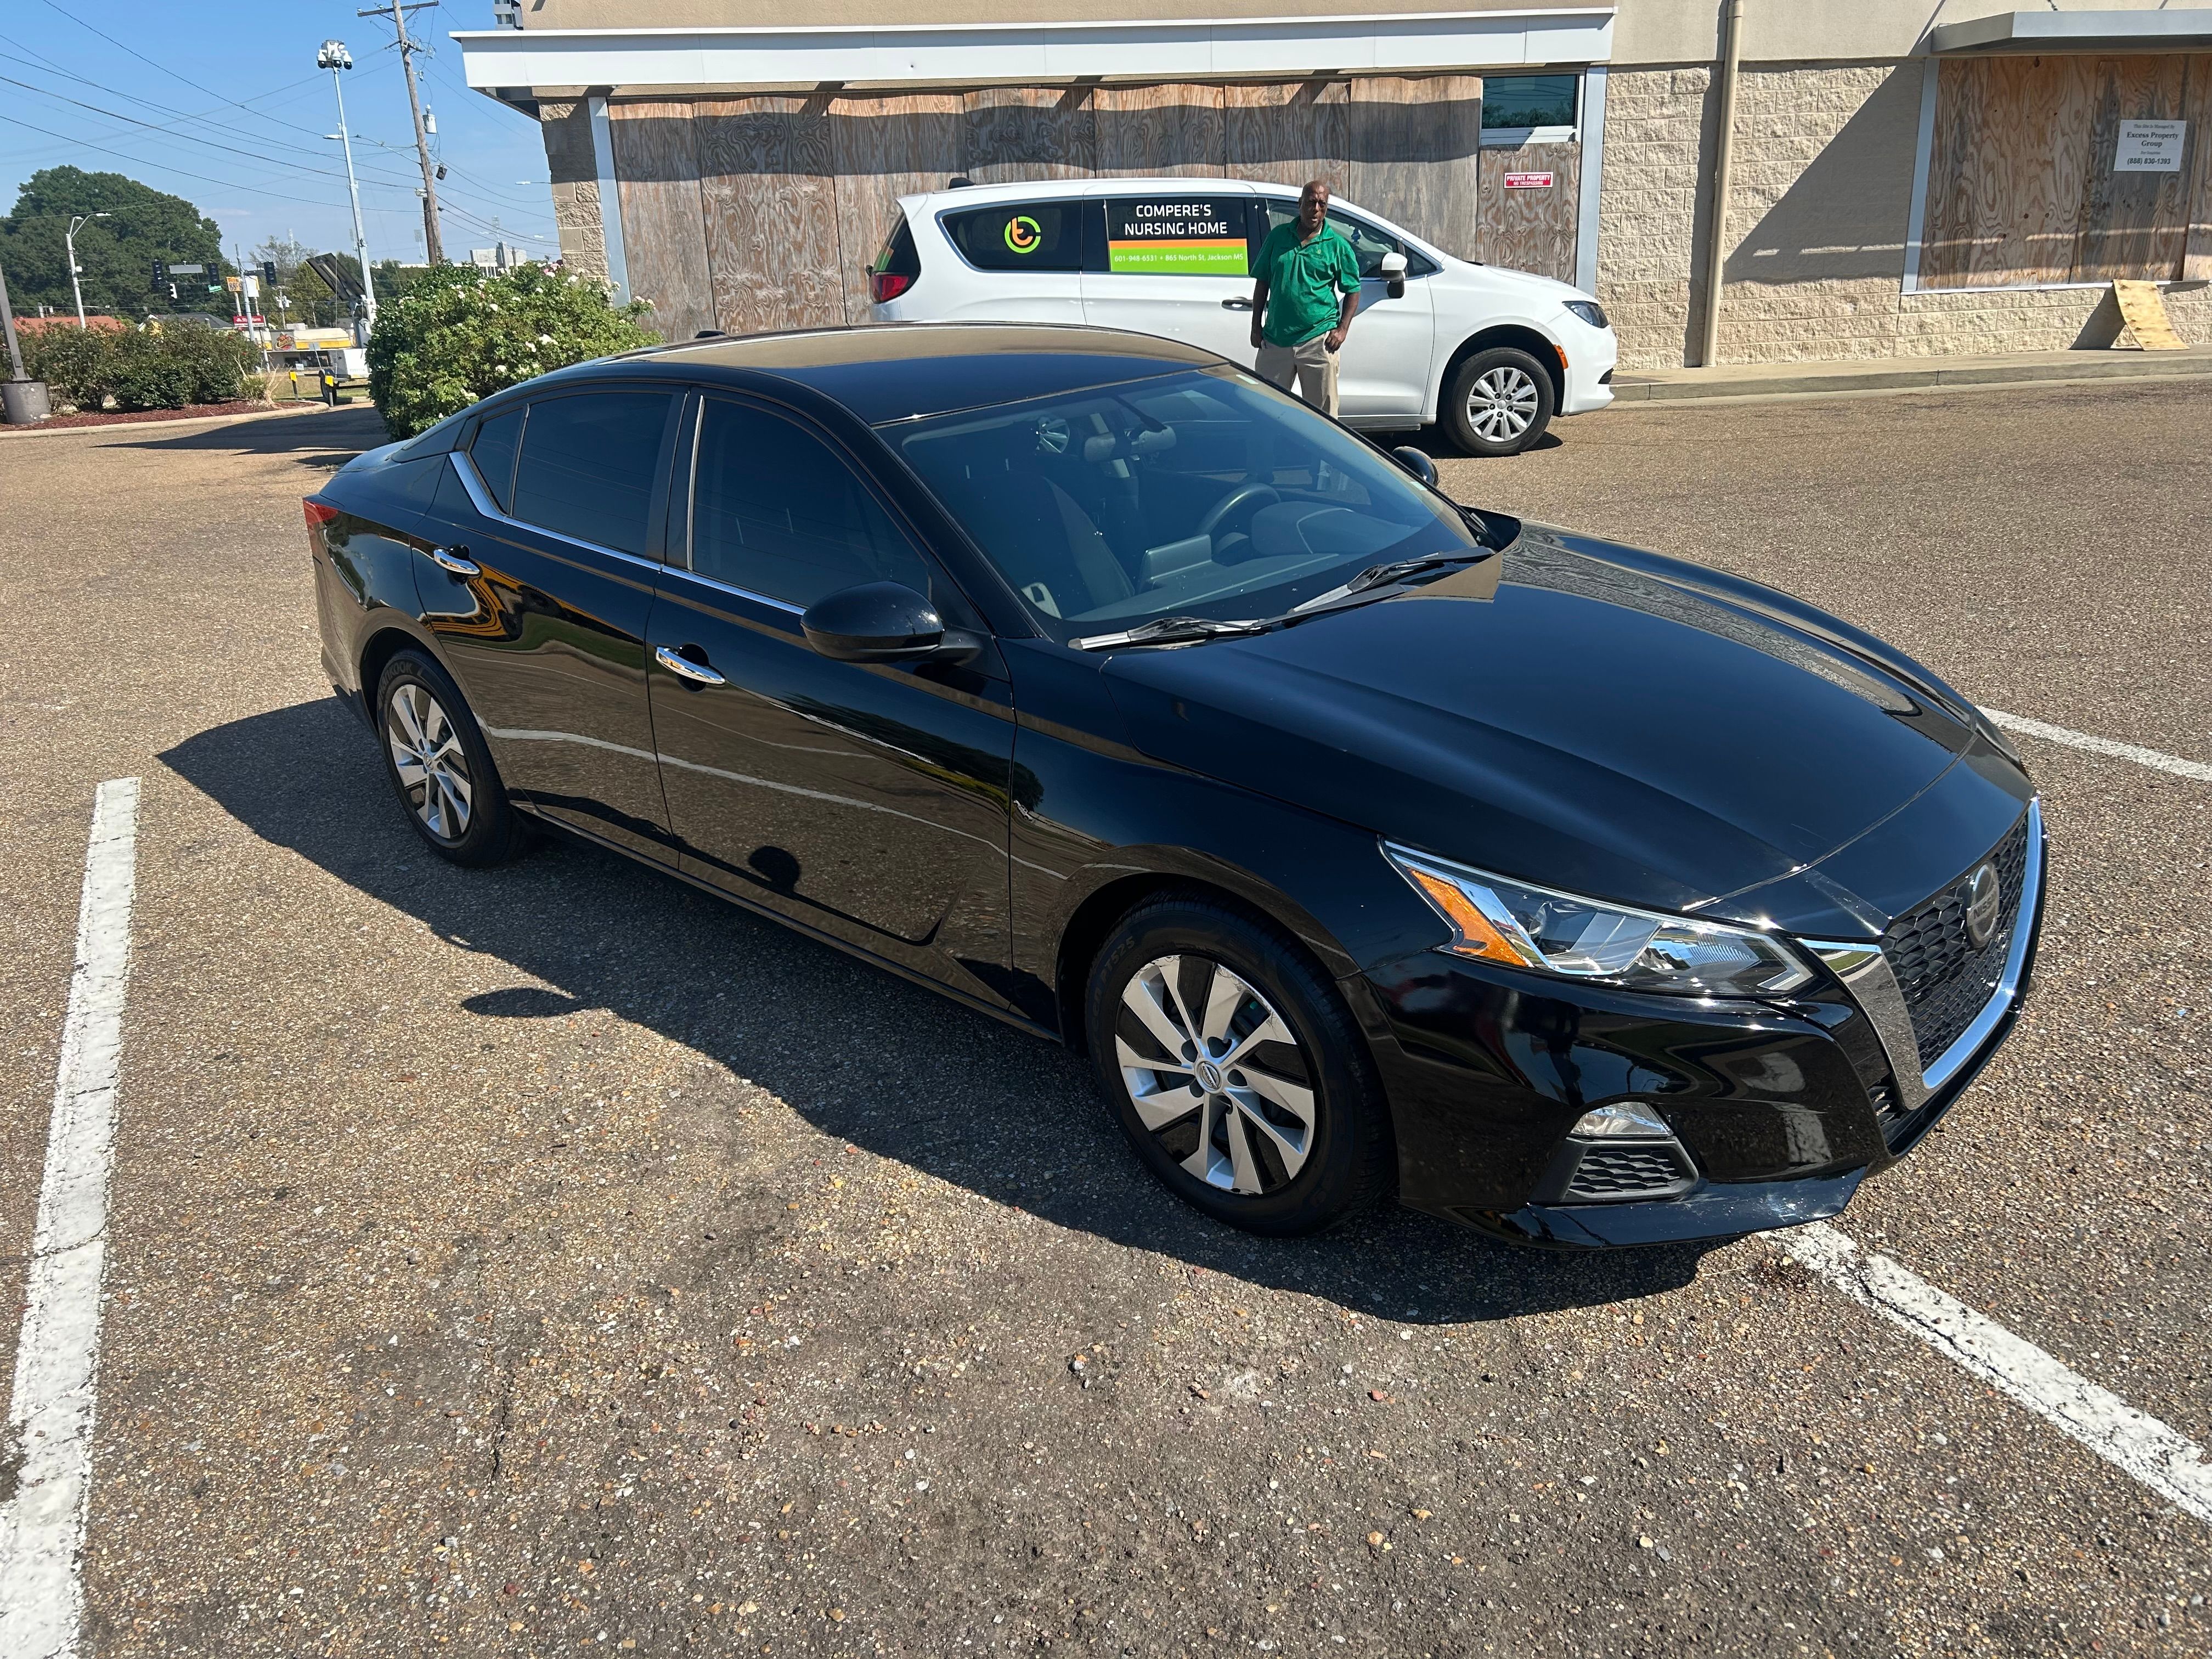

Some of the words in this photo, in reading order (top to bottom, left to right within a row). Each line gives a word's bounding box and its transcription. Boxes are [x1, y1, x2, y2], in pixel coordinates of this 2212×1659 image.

[2151, 132, 2179, 140] Property
[1136, 204, 1211, 217] COMPERE'S
[1125, 222, 1184, 235] NURSING
[1189, 222, 1227, 235] HOME
[1101, 935, 1136, 982] PT525
[1201, 1065, 1215, 1087] NISSAN
